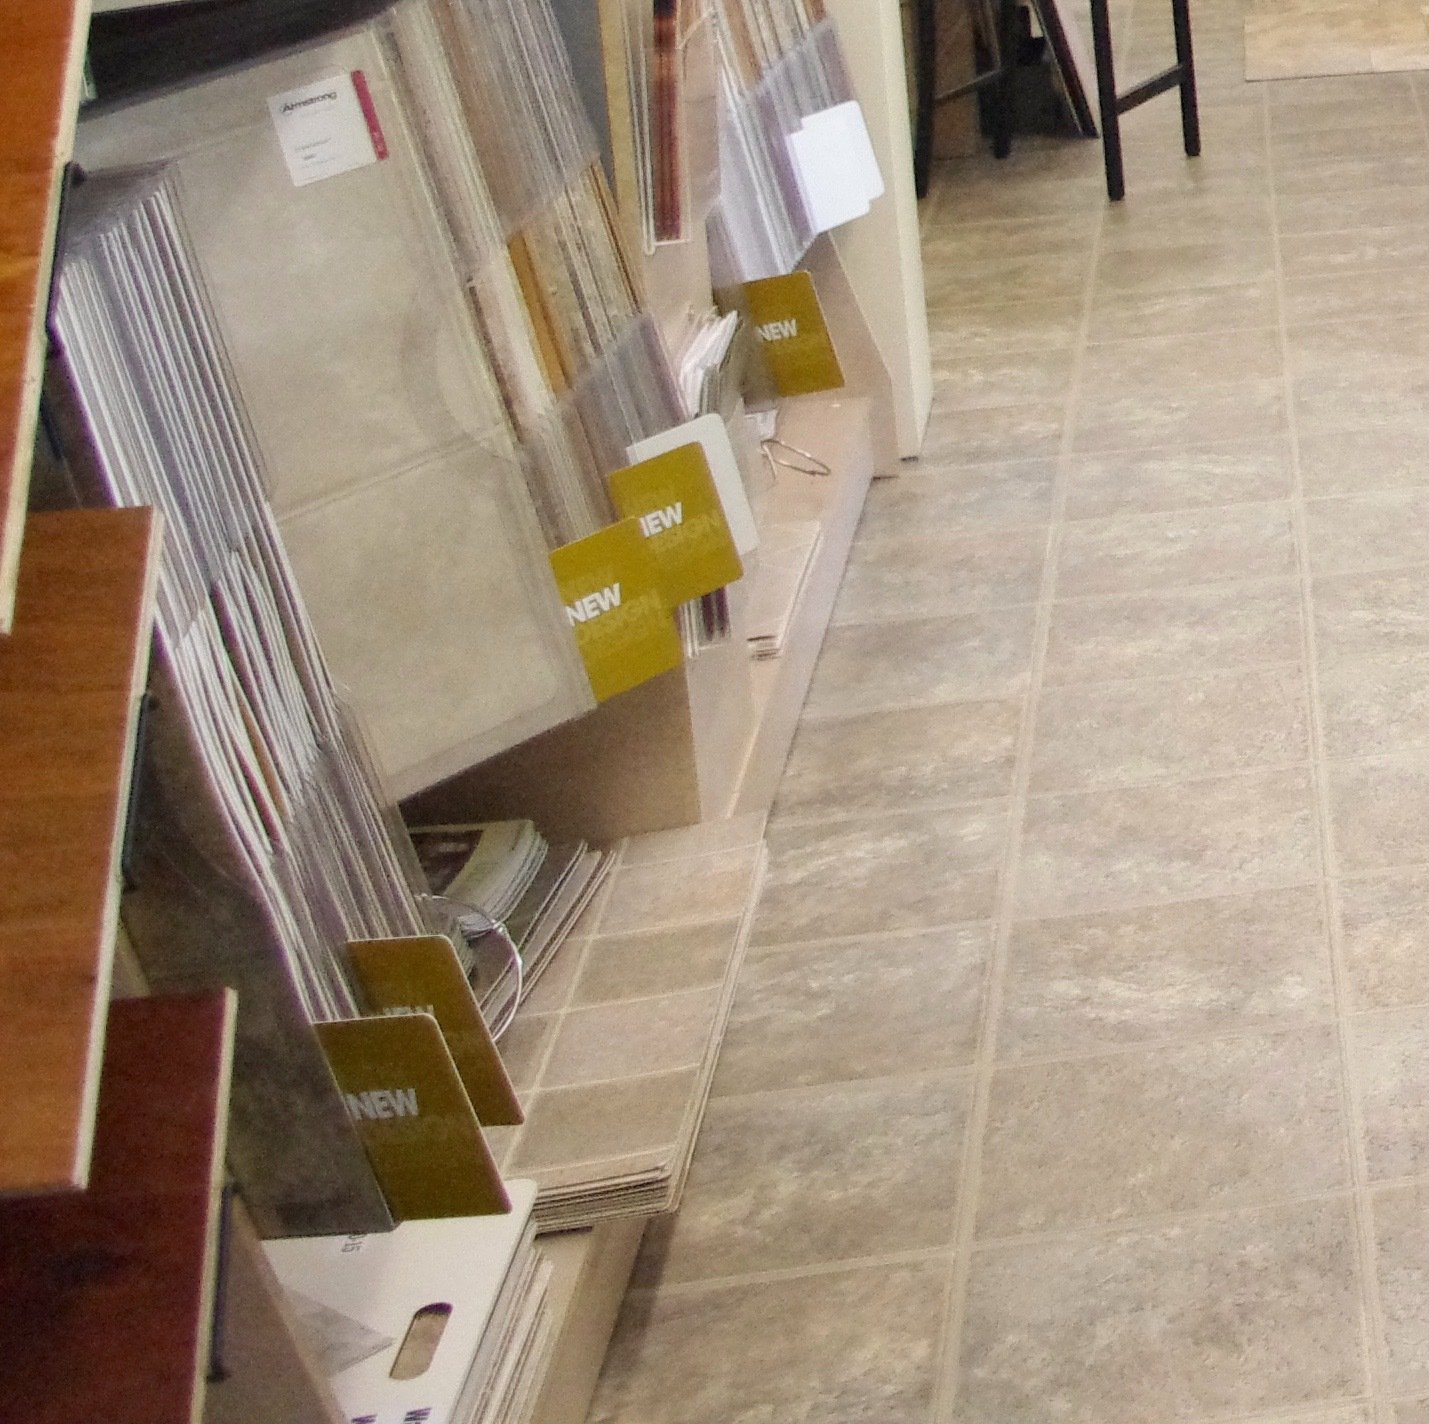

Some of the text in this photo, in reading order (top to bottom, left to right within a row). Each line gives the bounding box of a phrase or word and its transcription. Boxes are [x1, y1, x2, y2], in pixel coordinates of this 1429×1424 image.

[281, 91, 338, 113] Armstrong
[758, 319, 797, 343] NEW
[566, 582, 621, 627] NEW
[346, 1088, 420, 1121] NEW
